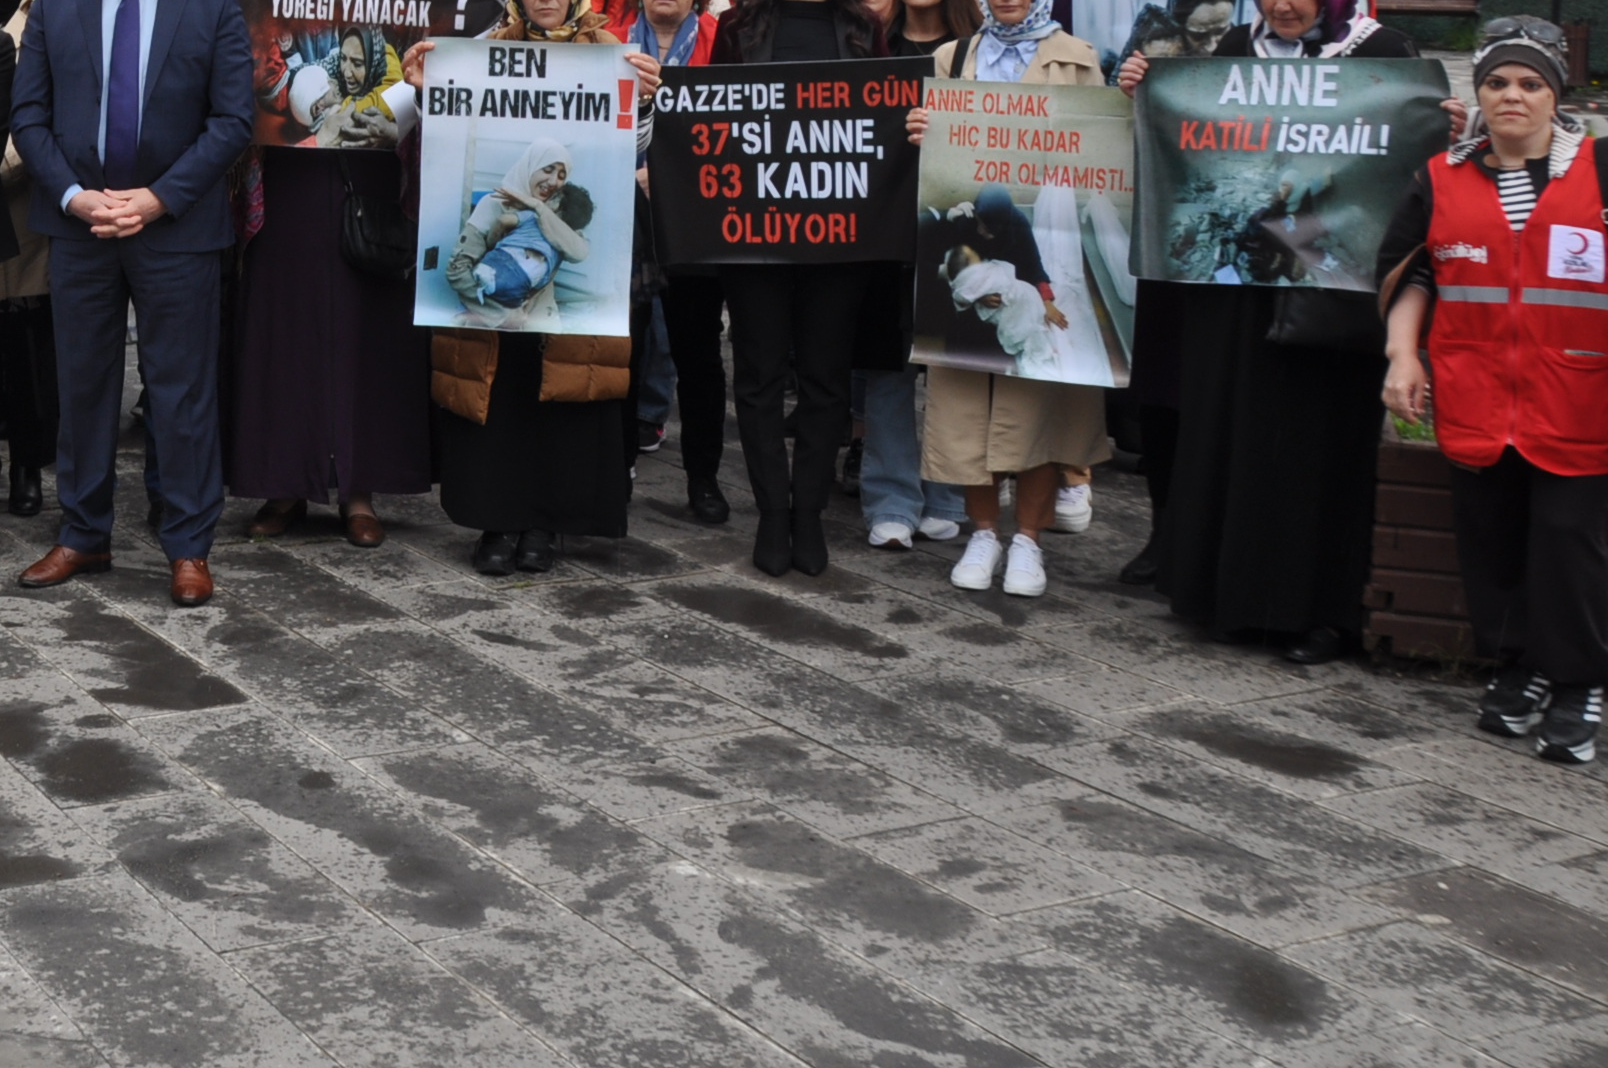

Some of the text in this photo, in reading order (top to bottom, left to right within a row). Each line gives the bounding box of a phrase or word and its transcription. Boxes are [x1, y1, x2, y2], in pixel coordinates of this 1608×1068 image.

[488, 46, 547, 78] BEN
[428, 79, 473, 116] BİR
[655, 75, 919, 113] GAZZE'DE HER GÜN
[924, 88, 1049, 117] ANNE OLMAK
[1218, 64, 1340, 107] ANNE
[691, 114, 884, 160] 37'Sİ ANNE,
[949, 120, 1080, 154] HİÇ BU KADAR
[1179, 116, 1390, 155] KATİLİ İSRAİL!
[699, 161, 869, 199] 63 KADIN
[974, 159, 1011, 183] ZOR
[722, 206, 857, 243] ÖLÜYOR!
